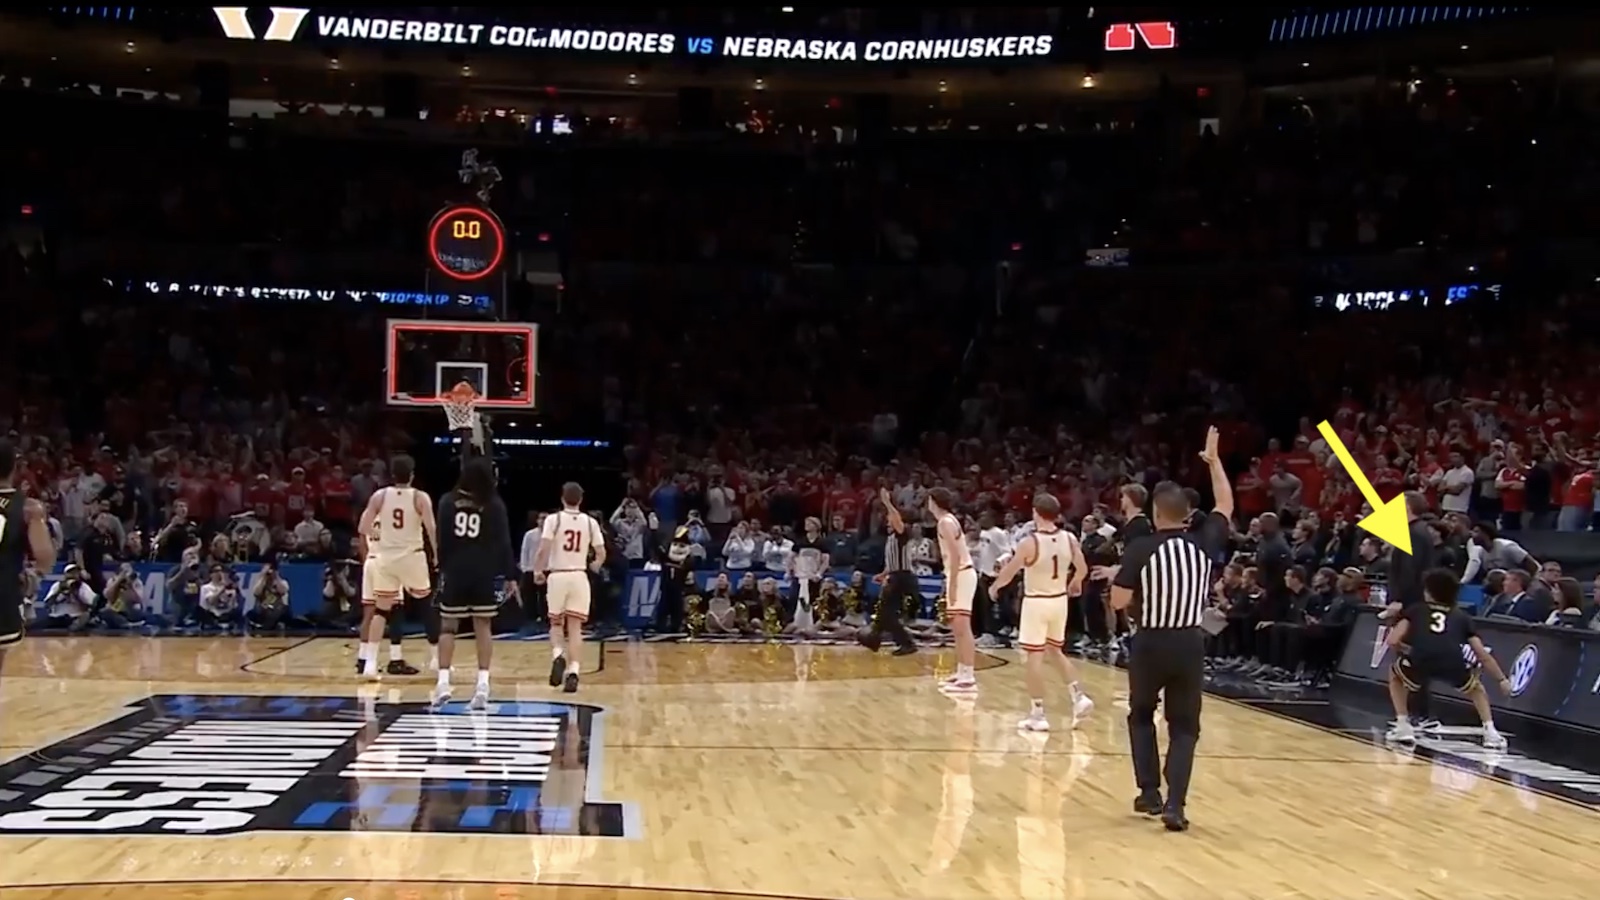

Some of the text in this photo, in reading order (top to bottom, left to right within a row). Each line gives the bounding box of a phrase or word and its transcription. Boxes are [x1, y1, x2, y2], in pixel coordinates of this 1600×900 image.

[318, 16, 1053, 61] VANDERBILT COMMODORES VS NEBRASKA CORNHUSKERS
[453, 220, 480, 238] 0.0
[392, 508, 404, 529] 9
[455, 511, 481, 538] 99
[563, 530, 582, 553] 31
[1051, 555, 1059, 580] 1
[1430, 611, 1446, 633] 3
[0, 719, 367, 830] MADNESS
